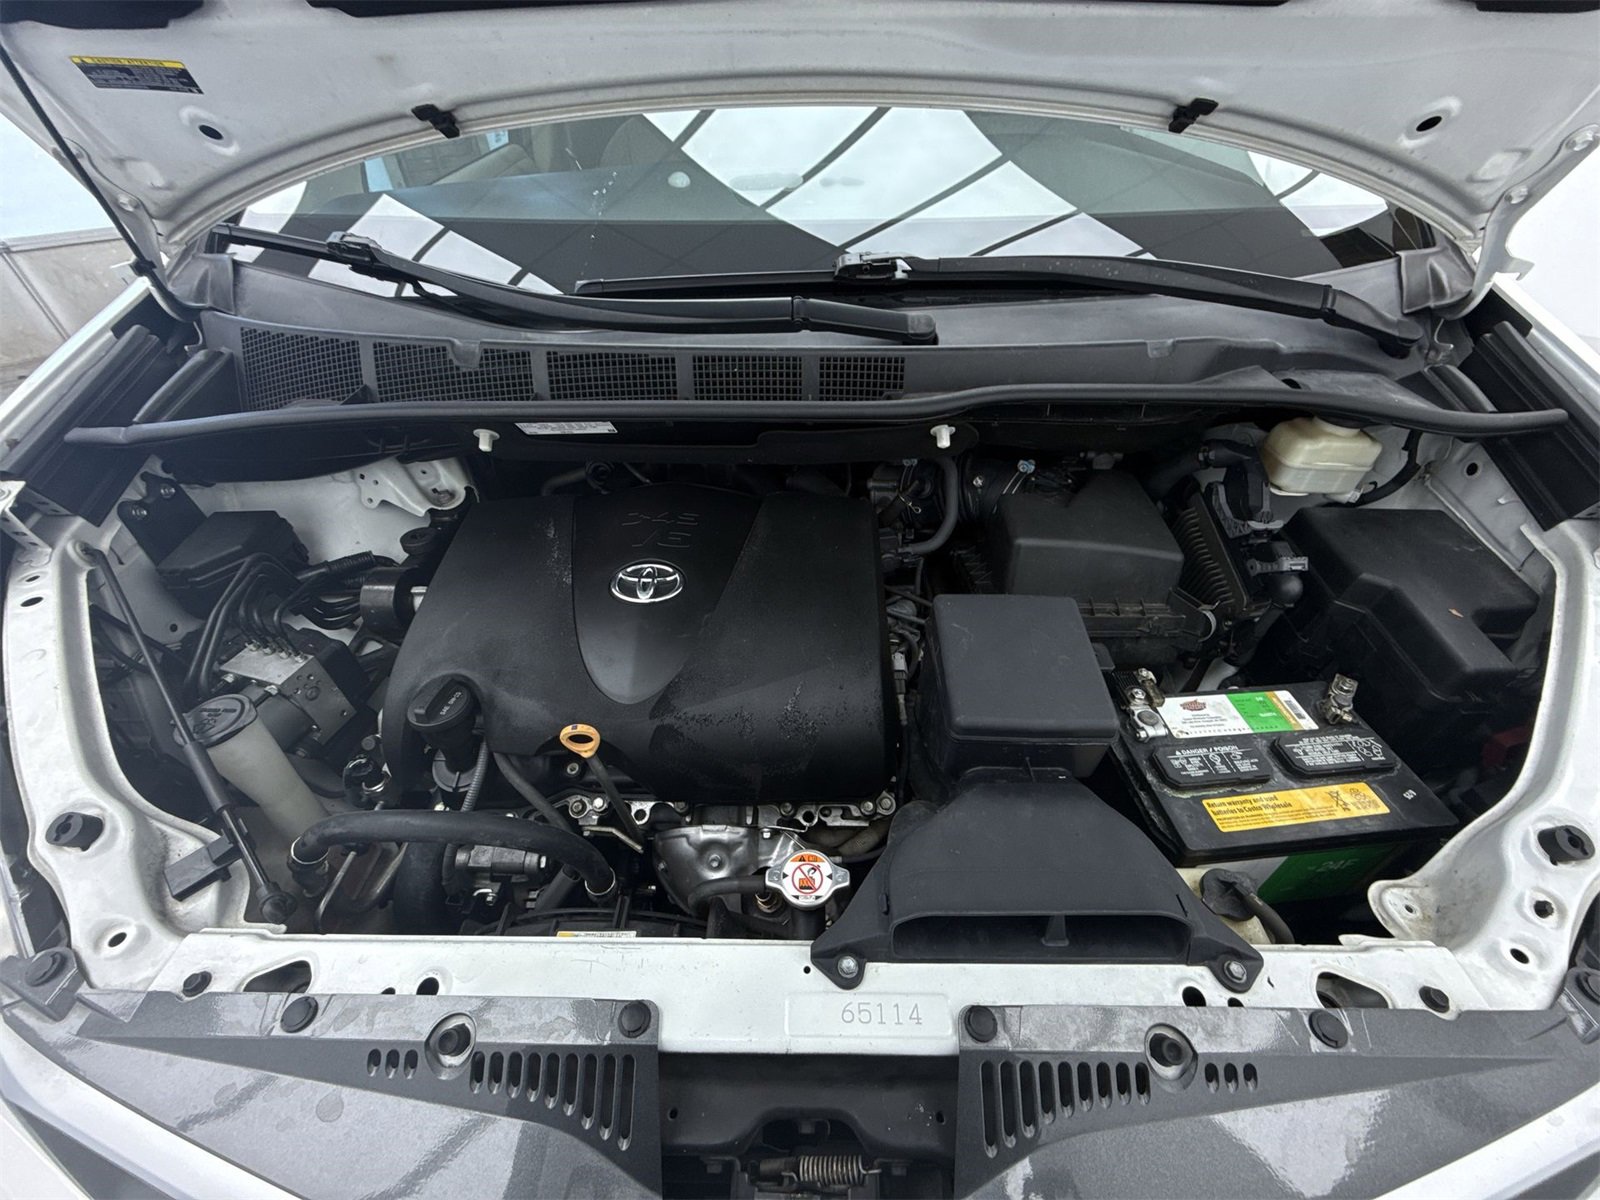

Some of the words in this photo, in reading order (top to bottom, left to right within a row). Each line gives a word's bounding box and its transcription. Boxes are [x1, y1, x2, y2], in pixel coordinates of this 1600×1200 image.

[1181, 747, 1209, 756] DANGER
[1213, 745, 1239, 753] POISON
[1206, 801, 1227, 809] Return
[1227, 798, 1253, 807] warranty
[841, 1002, 923, 1025] 65114
